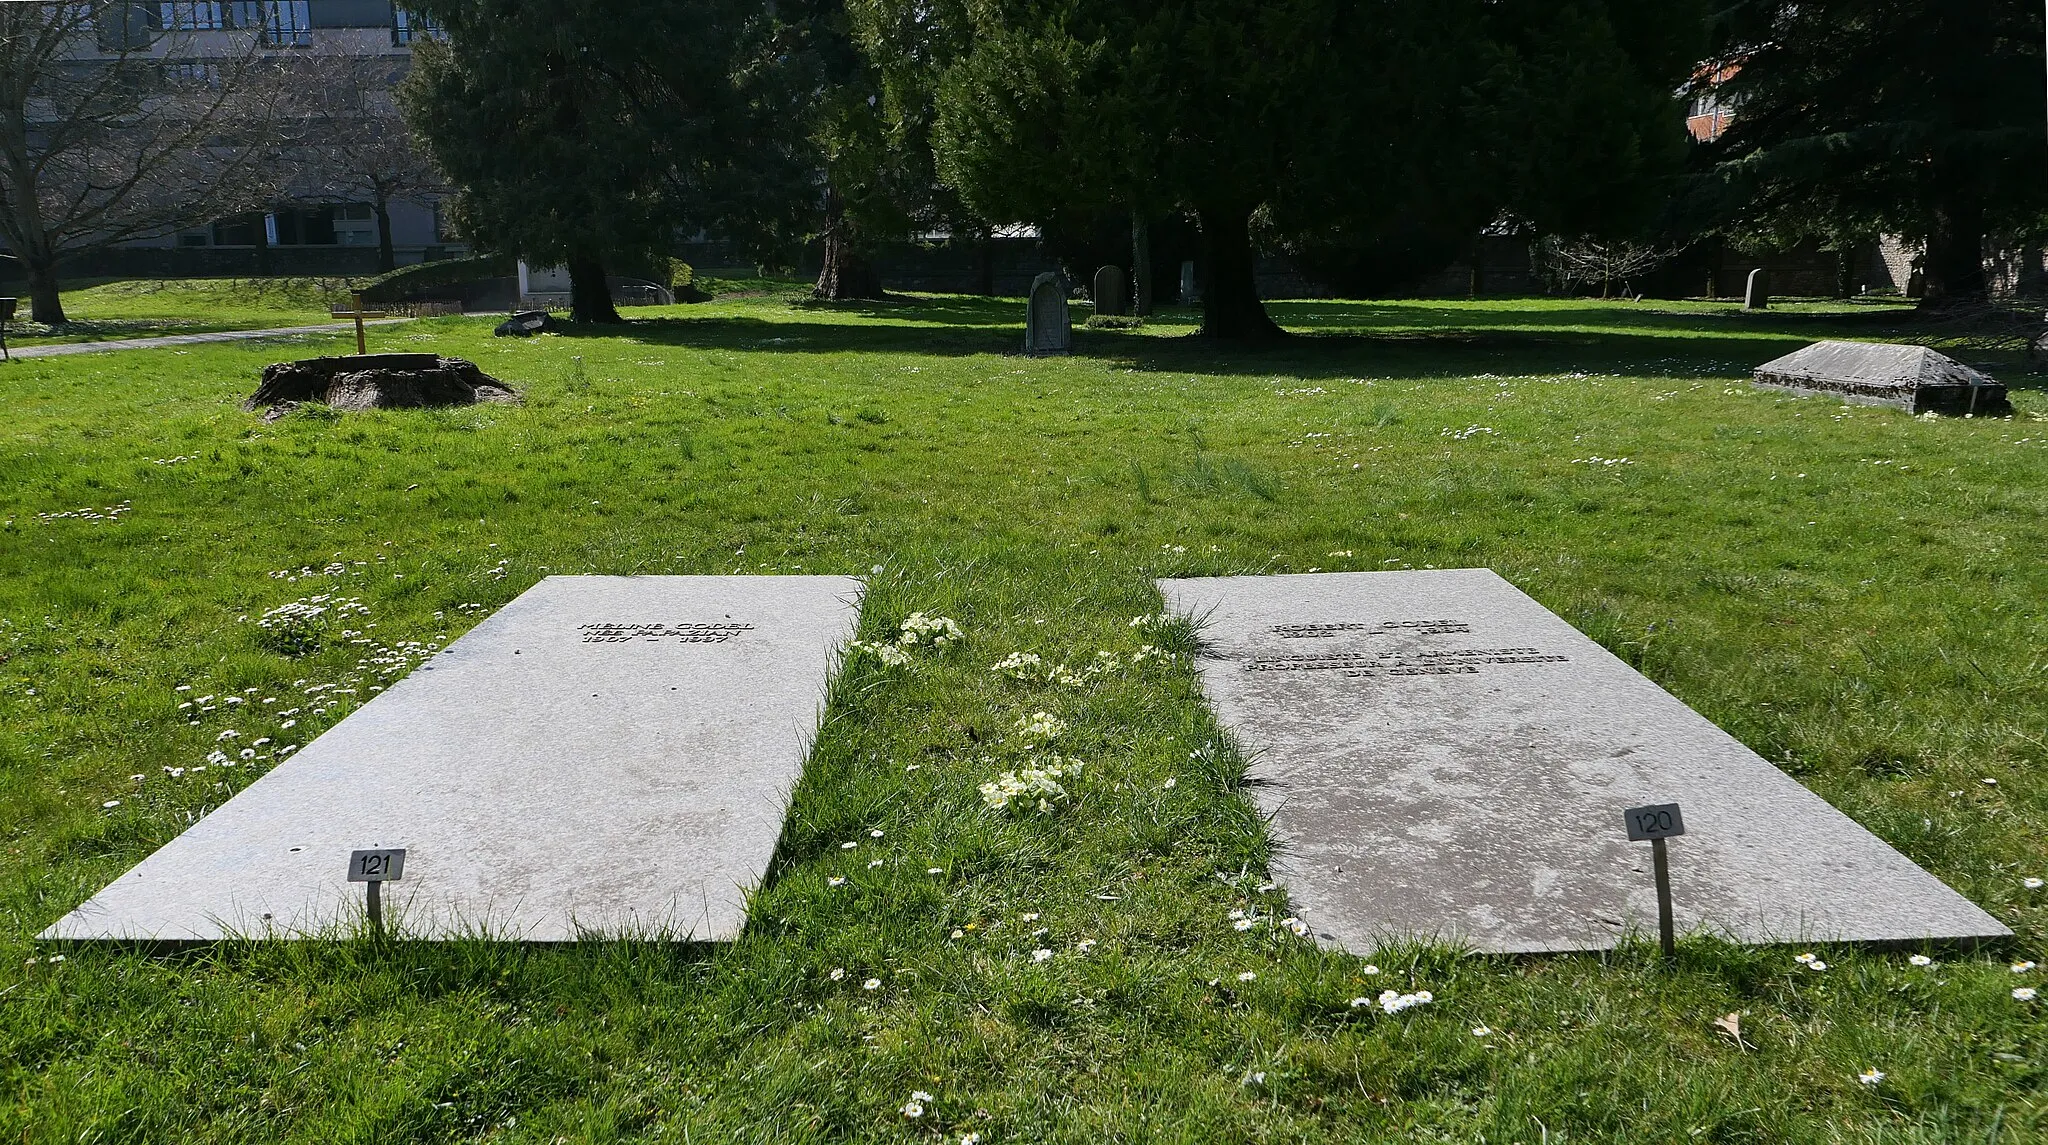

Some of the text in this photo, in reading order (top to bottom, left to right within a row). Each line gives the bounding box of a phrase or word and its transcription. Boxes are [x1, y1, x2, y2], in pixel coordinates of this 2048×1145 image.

[1269, 619, 1469, 632] ROBERT GODEL
[1253, 653, 1365, 663] LINGUISTE
[1243, 660, 1384, 671] PROFESSEUR
[1343, 669, 1376, 677] DE
[1635, 810, 1673, 833] 120
[360, 854, 391, 875] 121
